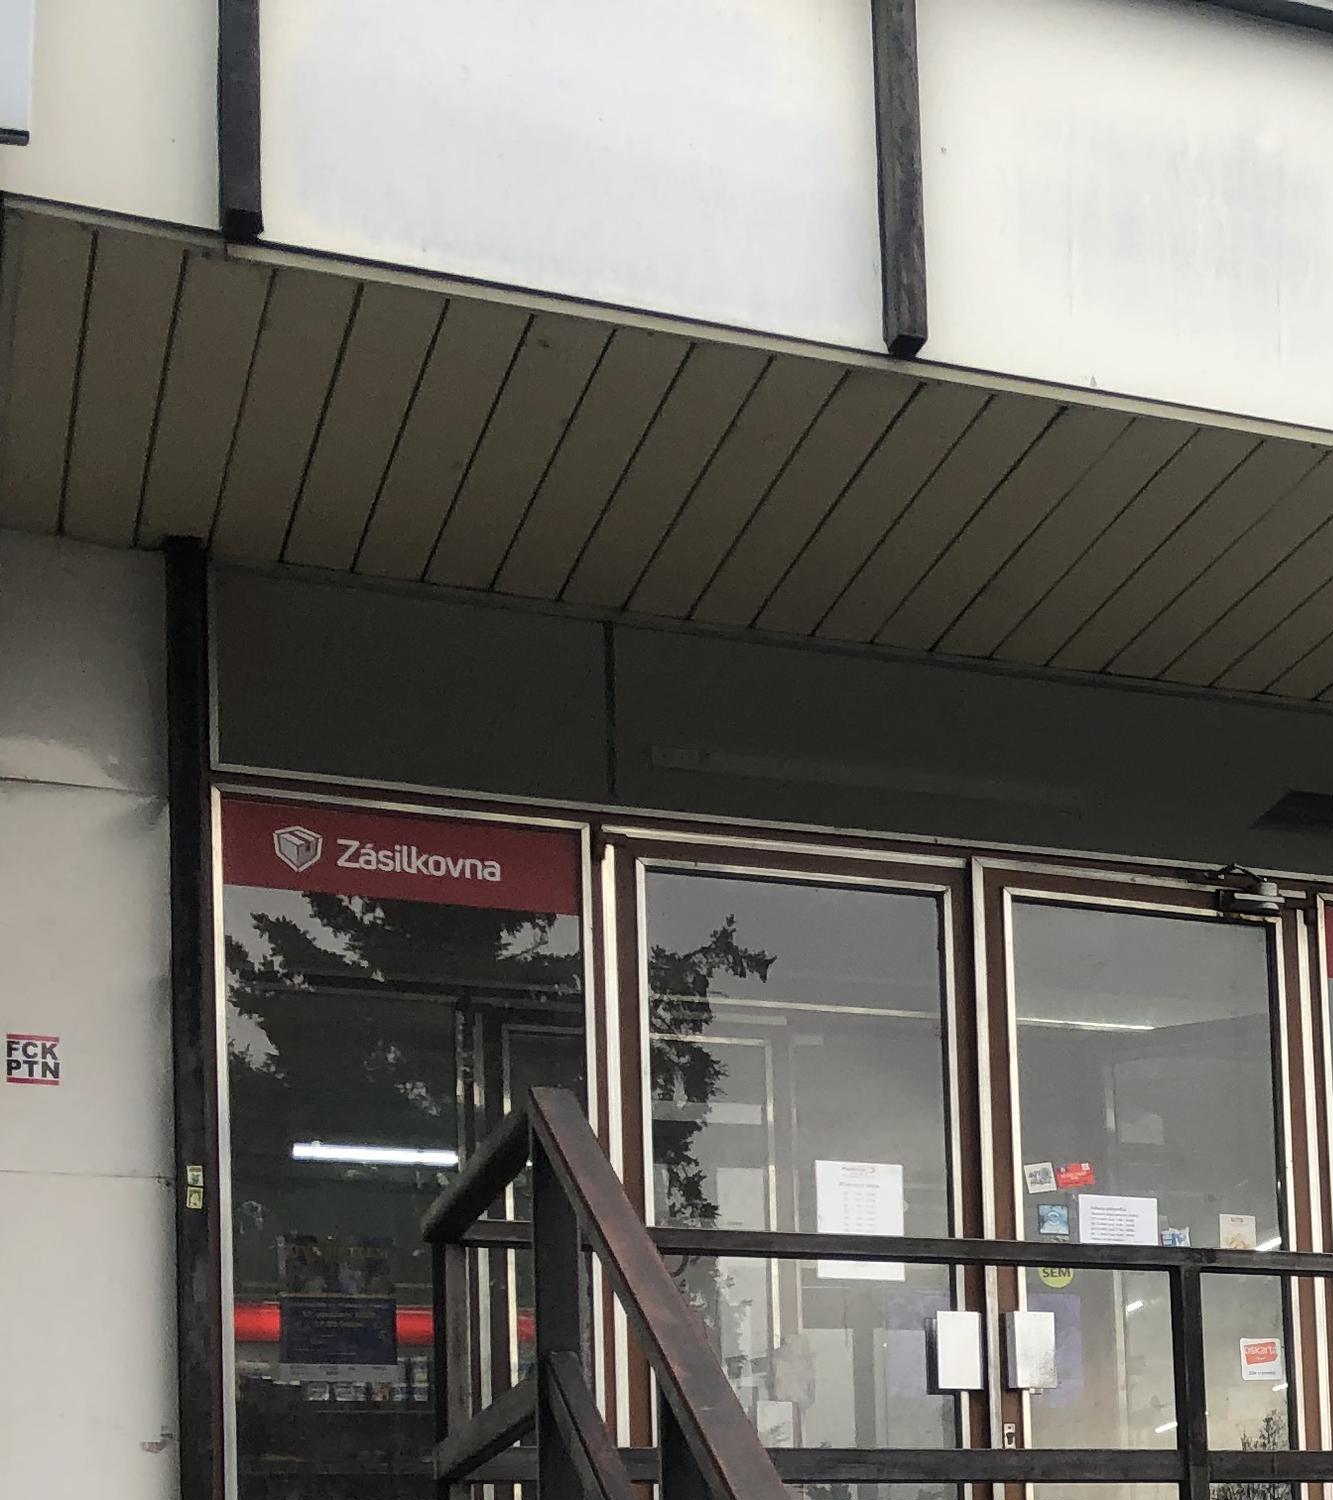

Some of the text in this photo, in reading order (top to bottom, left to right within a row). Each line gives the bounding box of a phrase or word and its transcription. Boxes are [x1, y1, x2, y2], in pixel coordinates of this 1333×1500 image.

[337, 838, 501, 882] Zásilkovna
[7, 1040, 58, 1060] FCK
[7, 1059, 60, 1079] PTN
[1042, 1267, 1072, 1278] SEM
